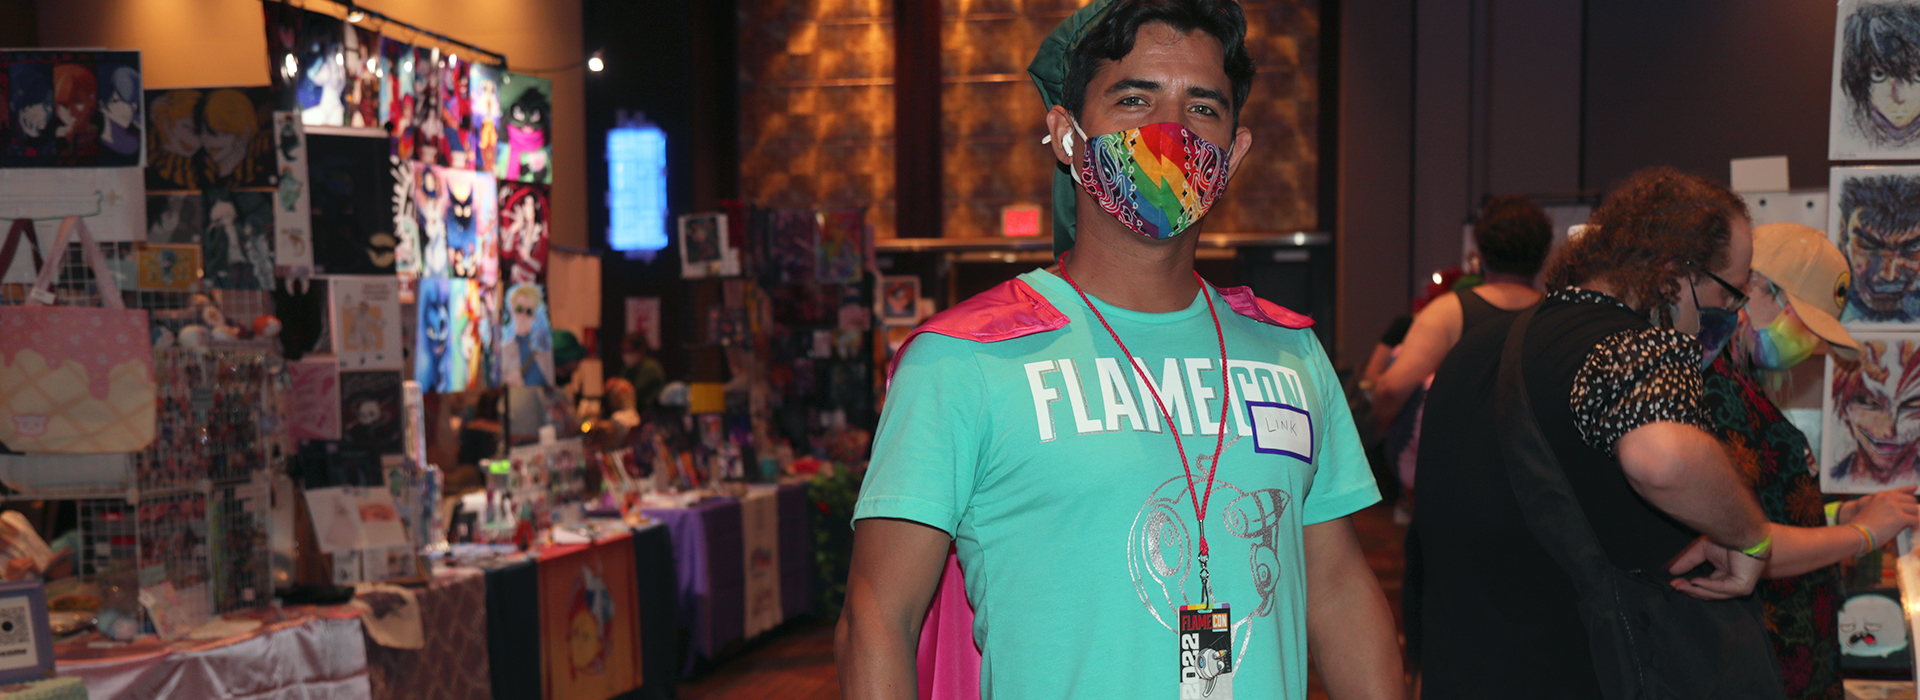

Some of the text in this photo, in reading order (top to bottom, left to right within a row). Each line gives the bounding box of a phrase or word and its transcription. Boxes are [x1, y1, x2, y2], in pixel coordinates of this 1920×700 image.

[1024, 356, 1306, 443] FLAME CON
[1264, 417, 1298, 437] LINK
[1181, 613, 1228, 631] FLAME CON
[1181, 632, 1200, 700] 2022
